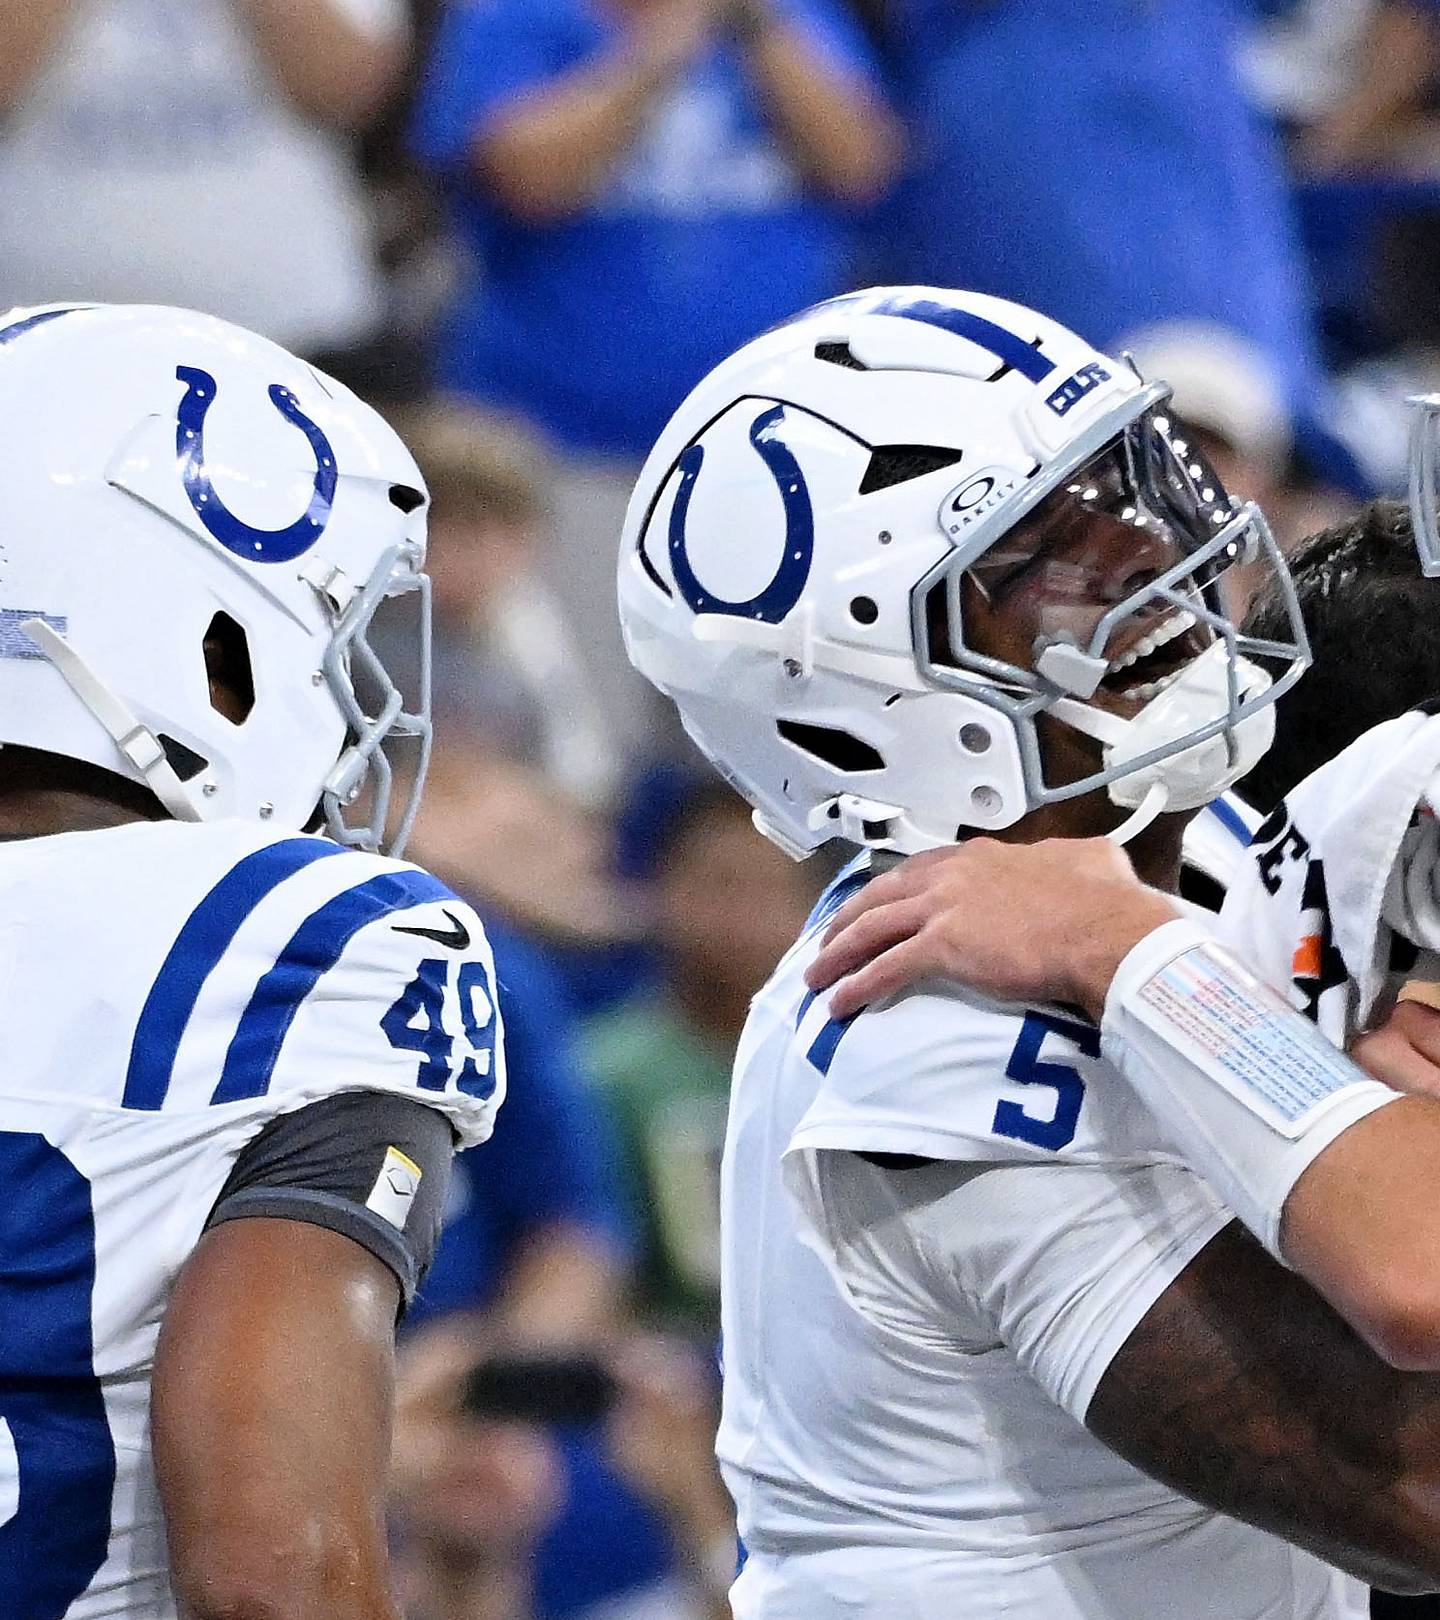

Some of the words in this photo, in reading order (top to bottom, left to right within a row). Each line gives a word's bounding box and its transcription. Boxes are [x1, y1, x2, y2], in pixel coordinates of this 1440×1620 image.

[1044, 361, 1112, 418] COLTS
[949, 480, 1014, 535] OAKLEY
[379, 958, 497, 1101] 49
[991, 1009, 1102, 1151] 5
